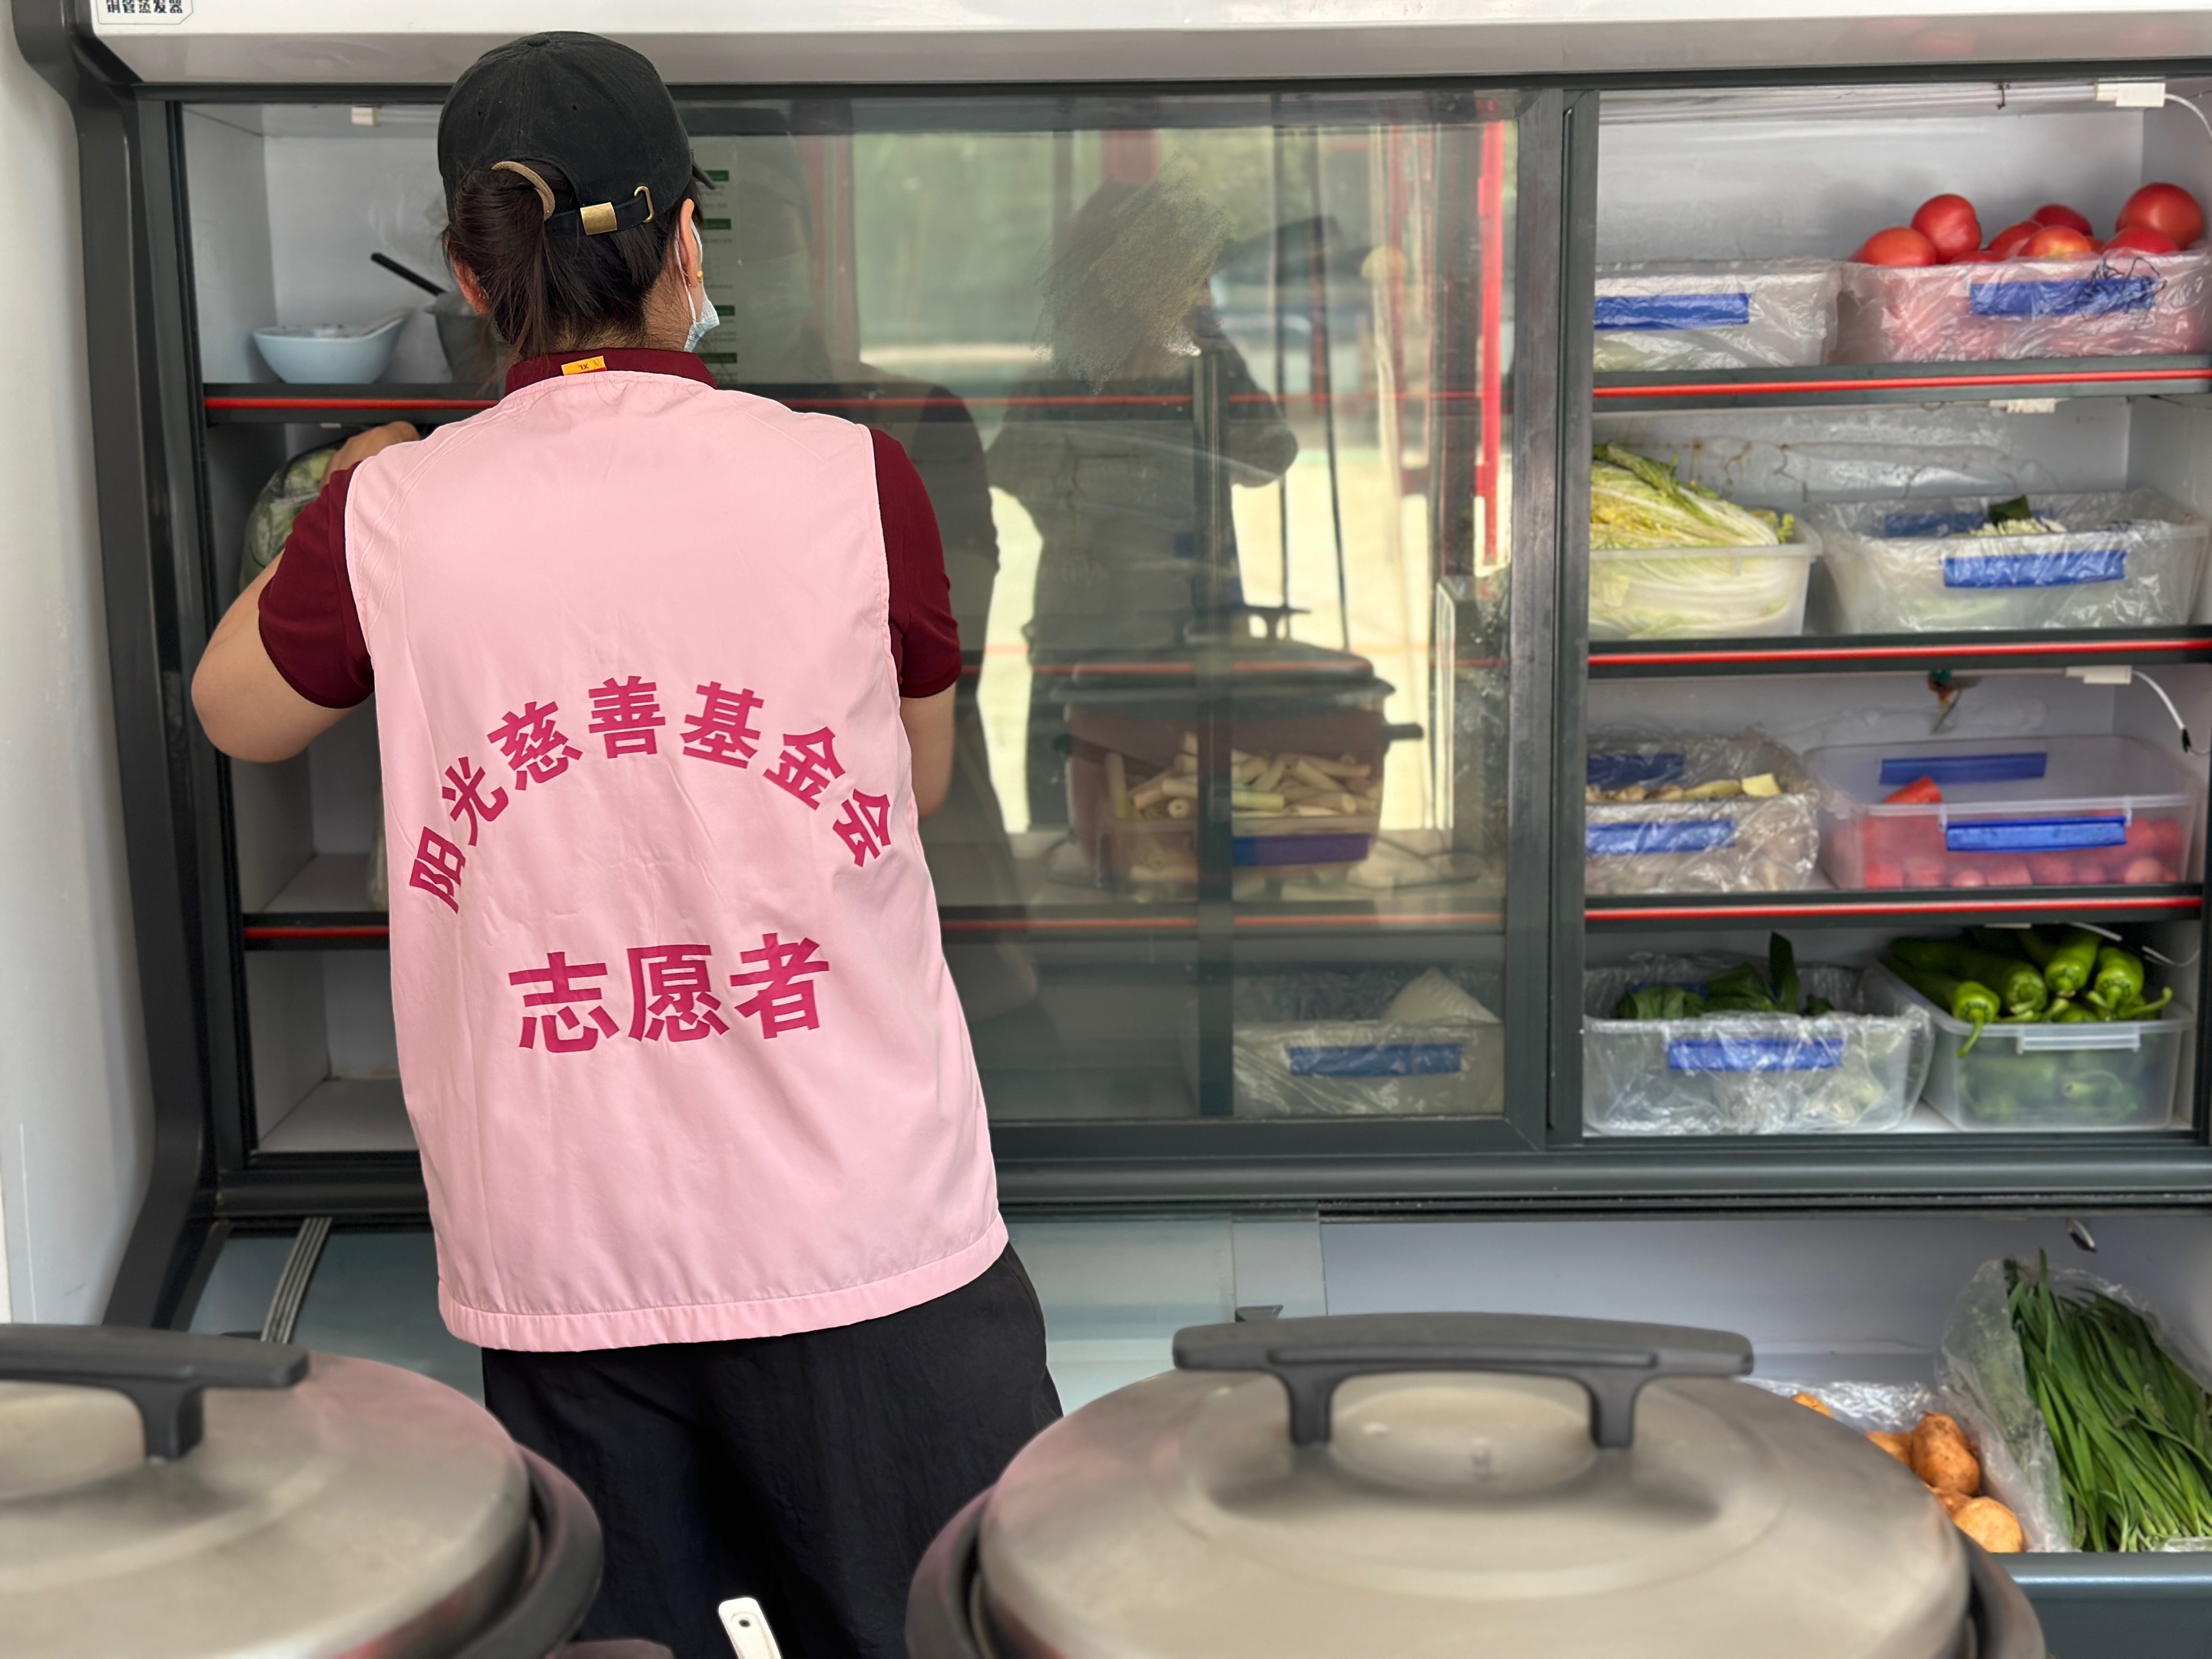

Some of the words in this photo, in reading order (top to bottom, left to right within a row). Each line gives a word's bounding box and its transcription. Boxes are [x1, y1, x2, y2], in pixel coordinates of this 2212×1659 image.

[409, 676, 891, 911] 阳光慈善基金会
[508, 933, 830, 1053] 志愿者
